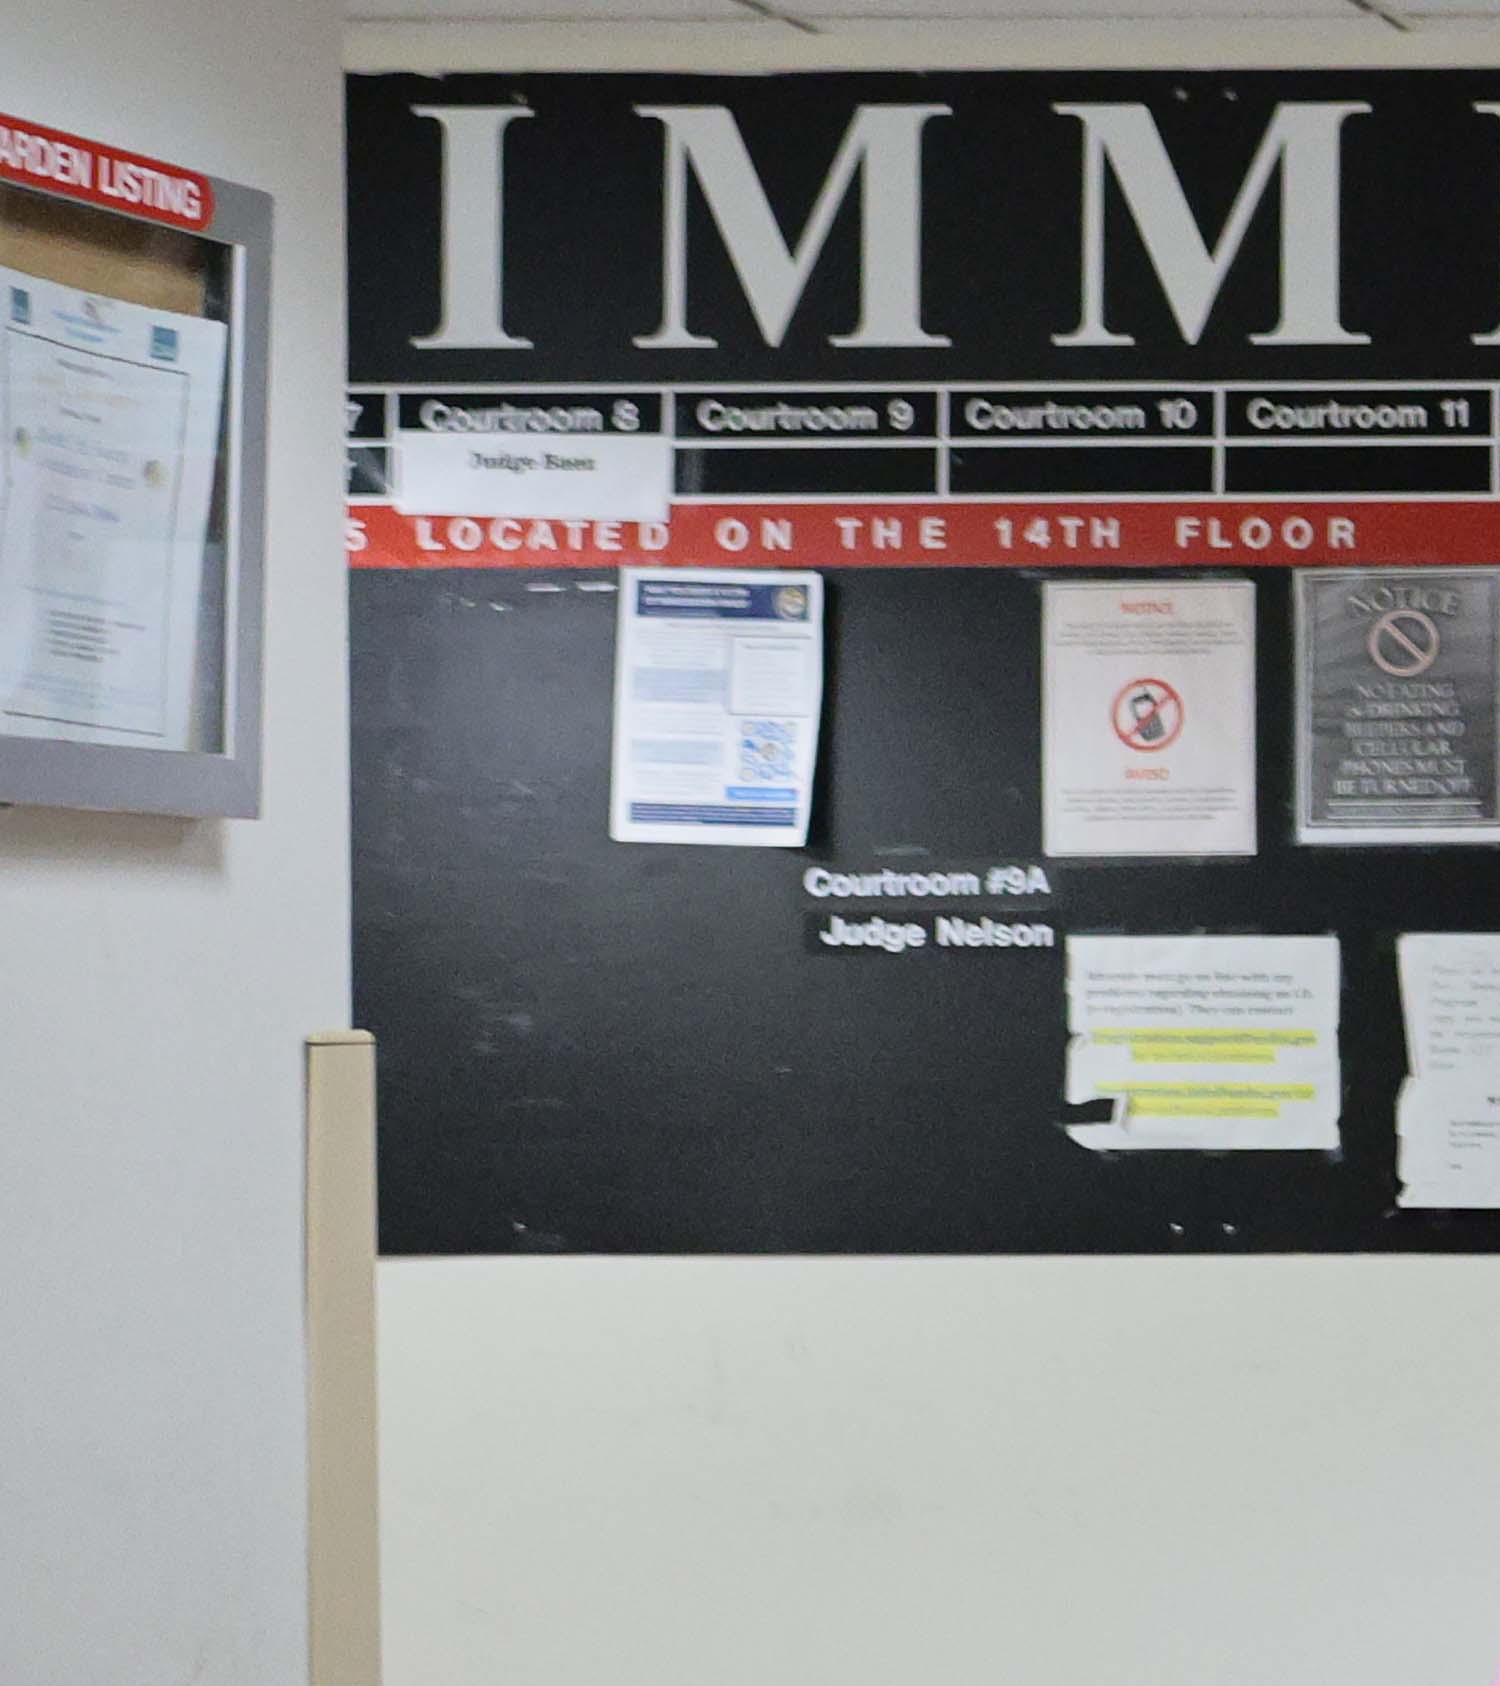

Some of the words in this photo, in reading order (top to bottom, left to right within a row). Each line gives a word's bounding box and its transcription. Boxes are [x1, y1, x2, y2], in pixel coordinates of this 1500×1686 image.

[98, 155, 201, 220] LISTING
[420, 401, 602, 432] Courtroom
[612, 400, 640, 431] 8
[699, 400, 878, 430] Courtroom
[889, 400, 914, 428] 9
[965, 399, 1145, 429] Courtroom
[1158, 399, 1197, 429] 10
[1246, 398, 1427, 429] Courtroom
[1441, 399, 1469, 427] 11
[472, 452, 536, 473] Judge
[416, 515, 670, 551] LOCATED
[716, 517, 793, 551] ON
[836, 516, 947, 550] THE
[994, 517, 1121, 549] 14TH
[1175, 516, 1356, 549] FLOOR
[803, 867, 979, 898] Courtroom
[986, 866, 1051, 896] #9A
[820, 916, 925, 953] Judge
[936, 916, 1054, 948] Nelson
